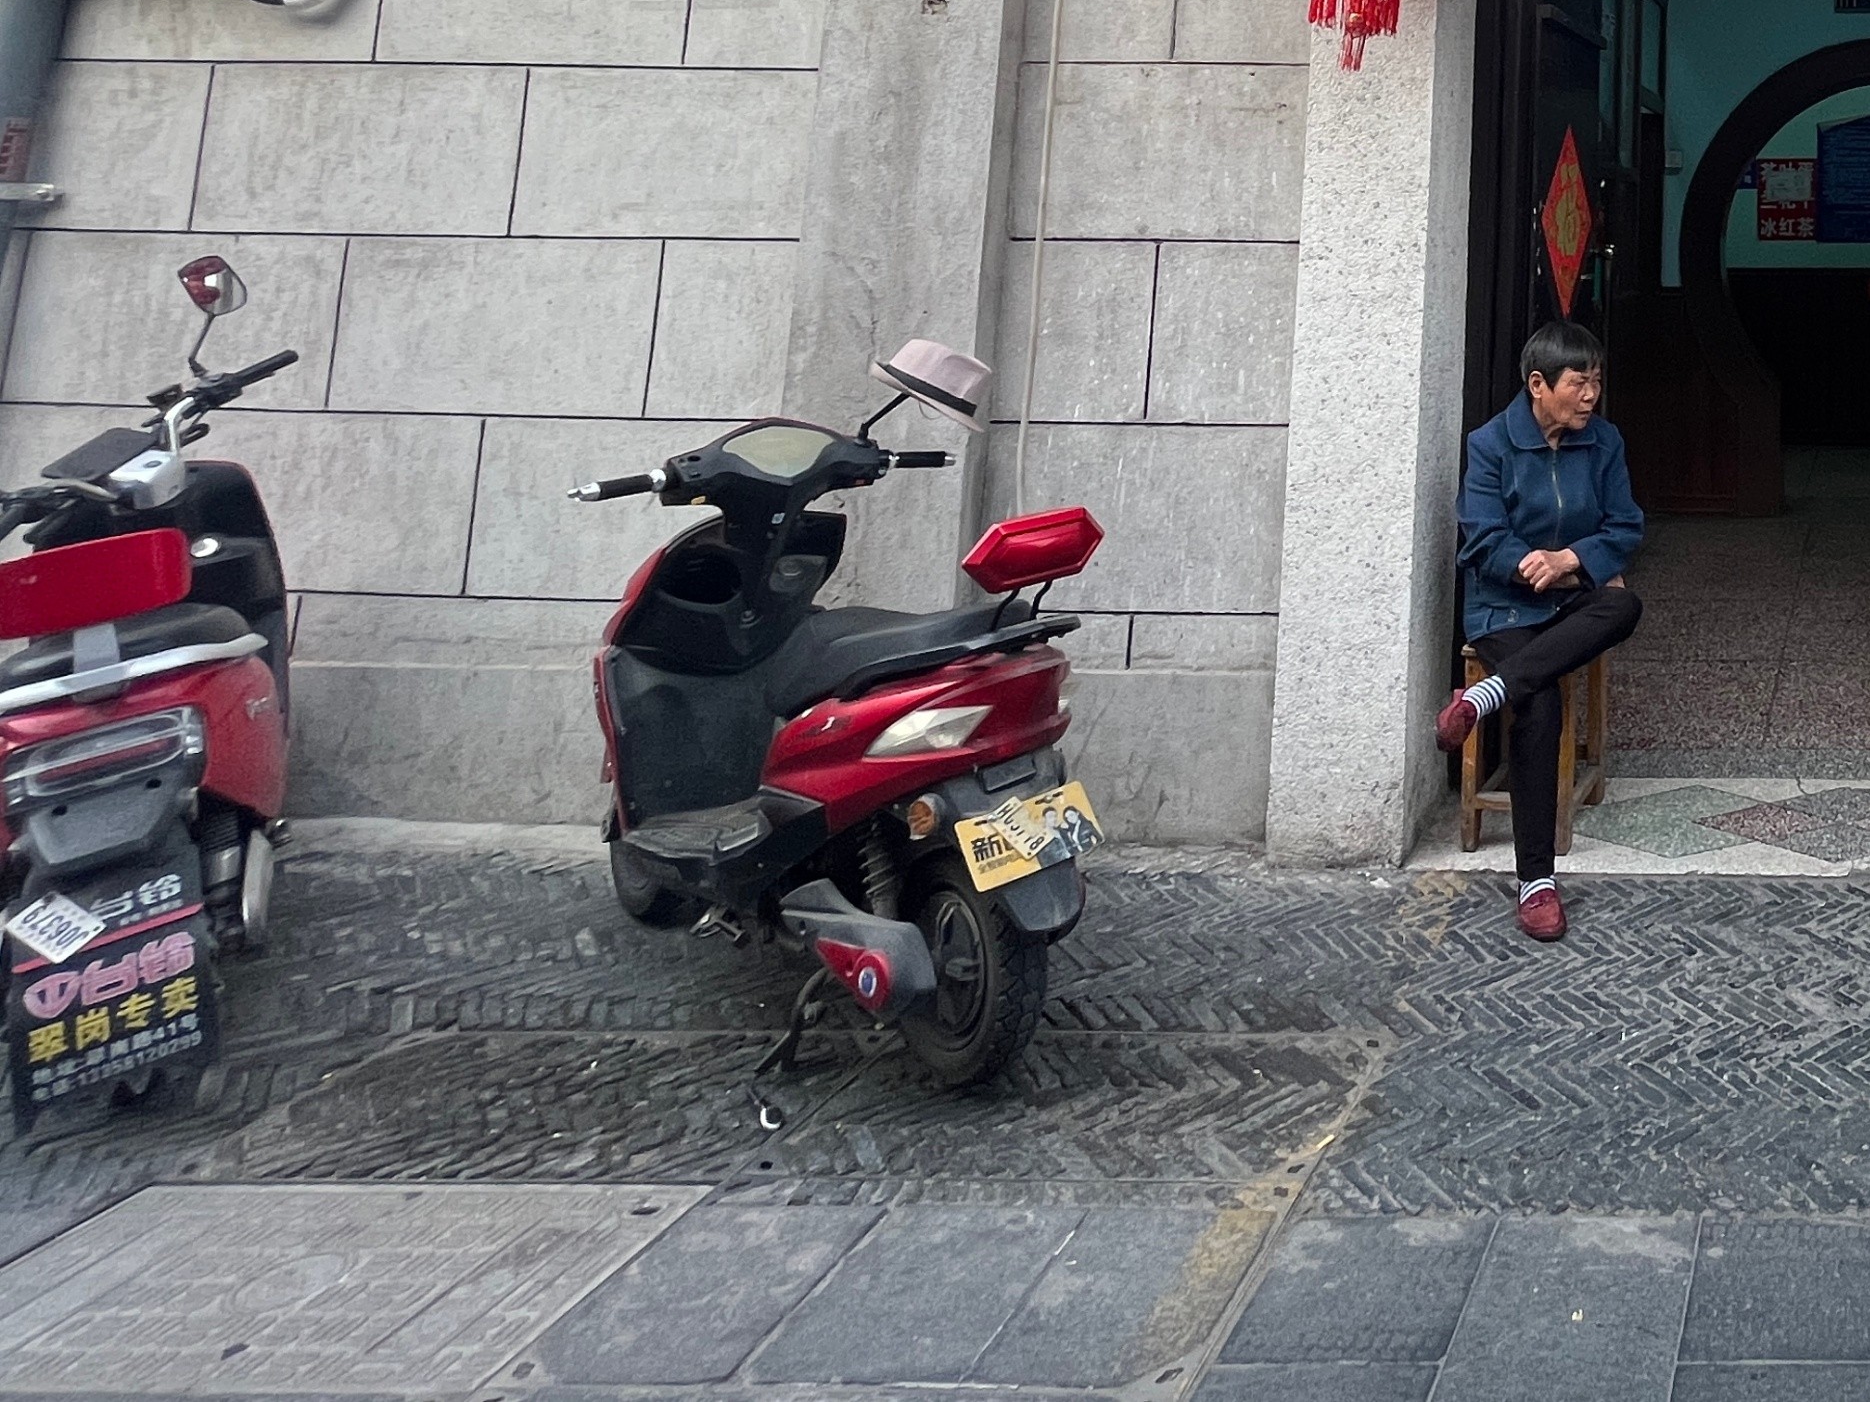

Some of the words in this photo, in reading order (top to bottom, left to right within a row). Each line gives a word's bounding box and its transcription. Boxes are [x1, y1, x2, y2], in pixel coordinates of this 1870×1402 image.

[1760, 217, 1815, 238] 冰红茶
[81, 931, 197, 1006] 台铃
